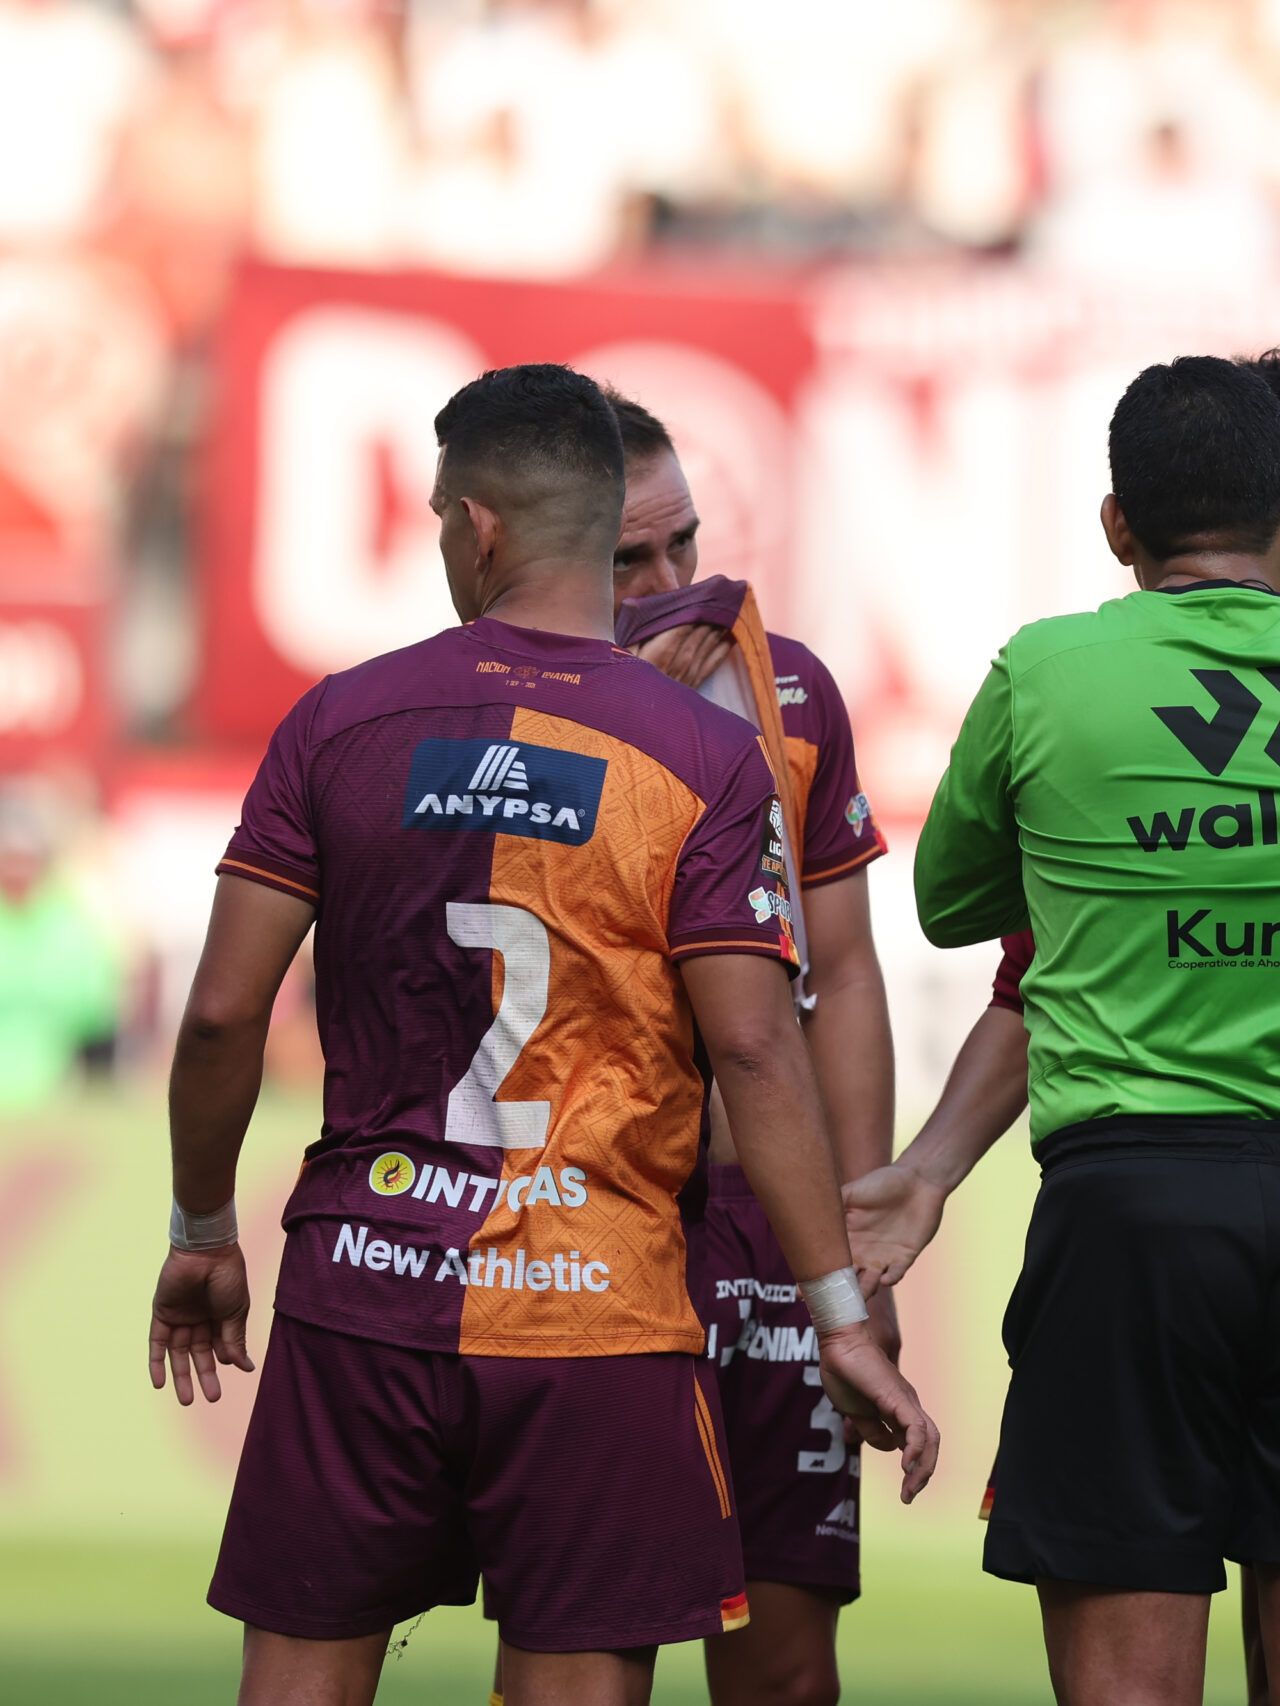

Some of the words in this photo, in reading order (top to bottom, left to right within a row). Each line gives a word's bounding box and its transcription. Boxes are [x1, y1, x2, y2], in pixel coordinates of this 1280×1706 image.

[769, 839, 783, 856] LIG
[1168, 959, 1237, 971] Cooperativa
[1240, 959, 1255, 968] de
[445, 901, 551, 1150] 2
[332, 1223, 430, 1278] New
[434, 1247, 611, 1293] Athletic
